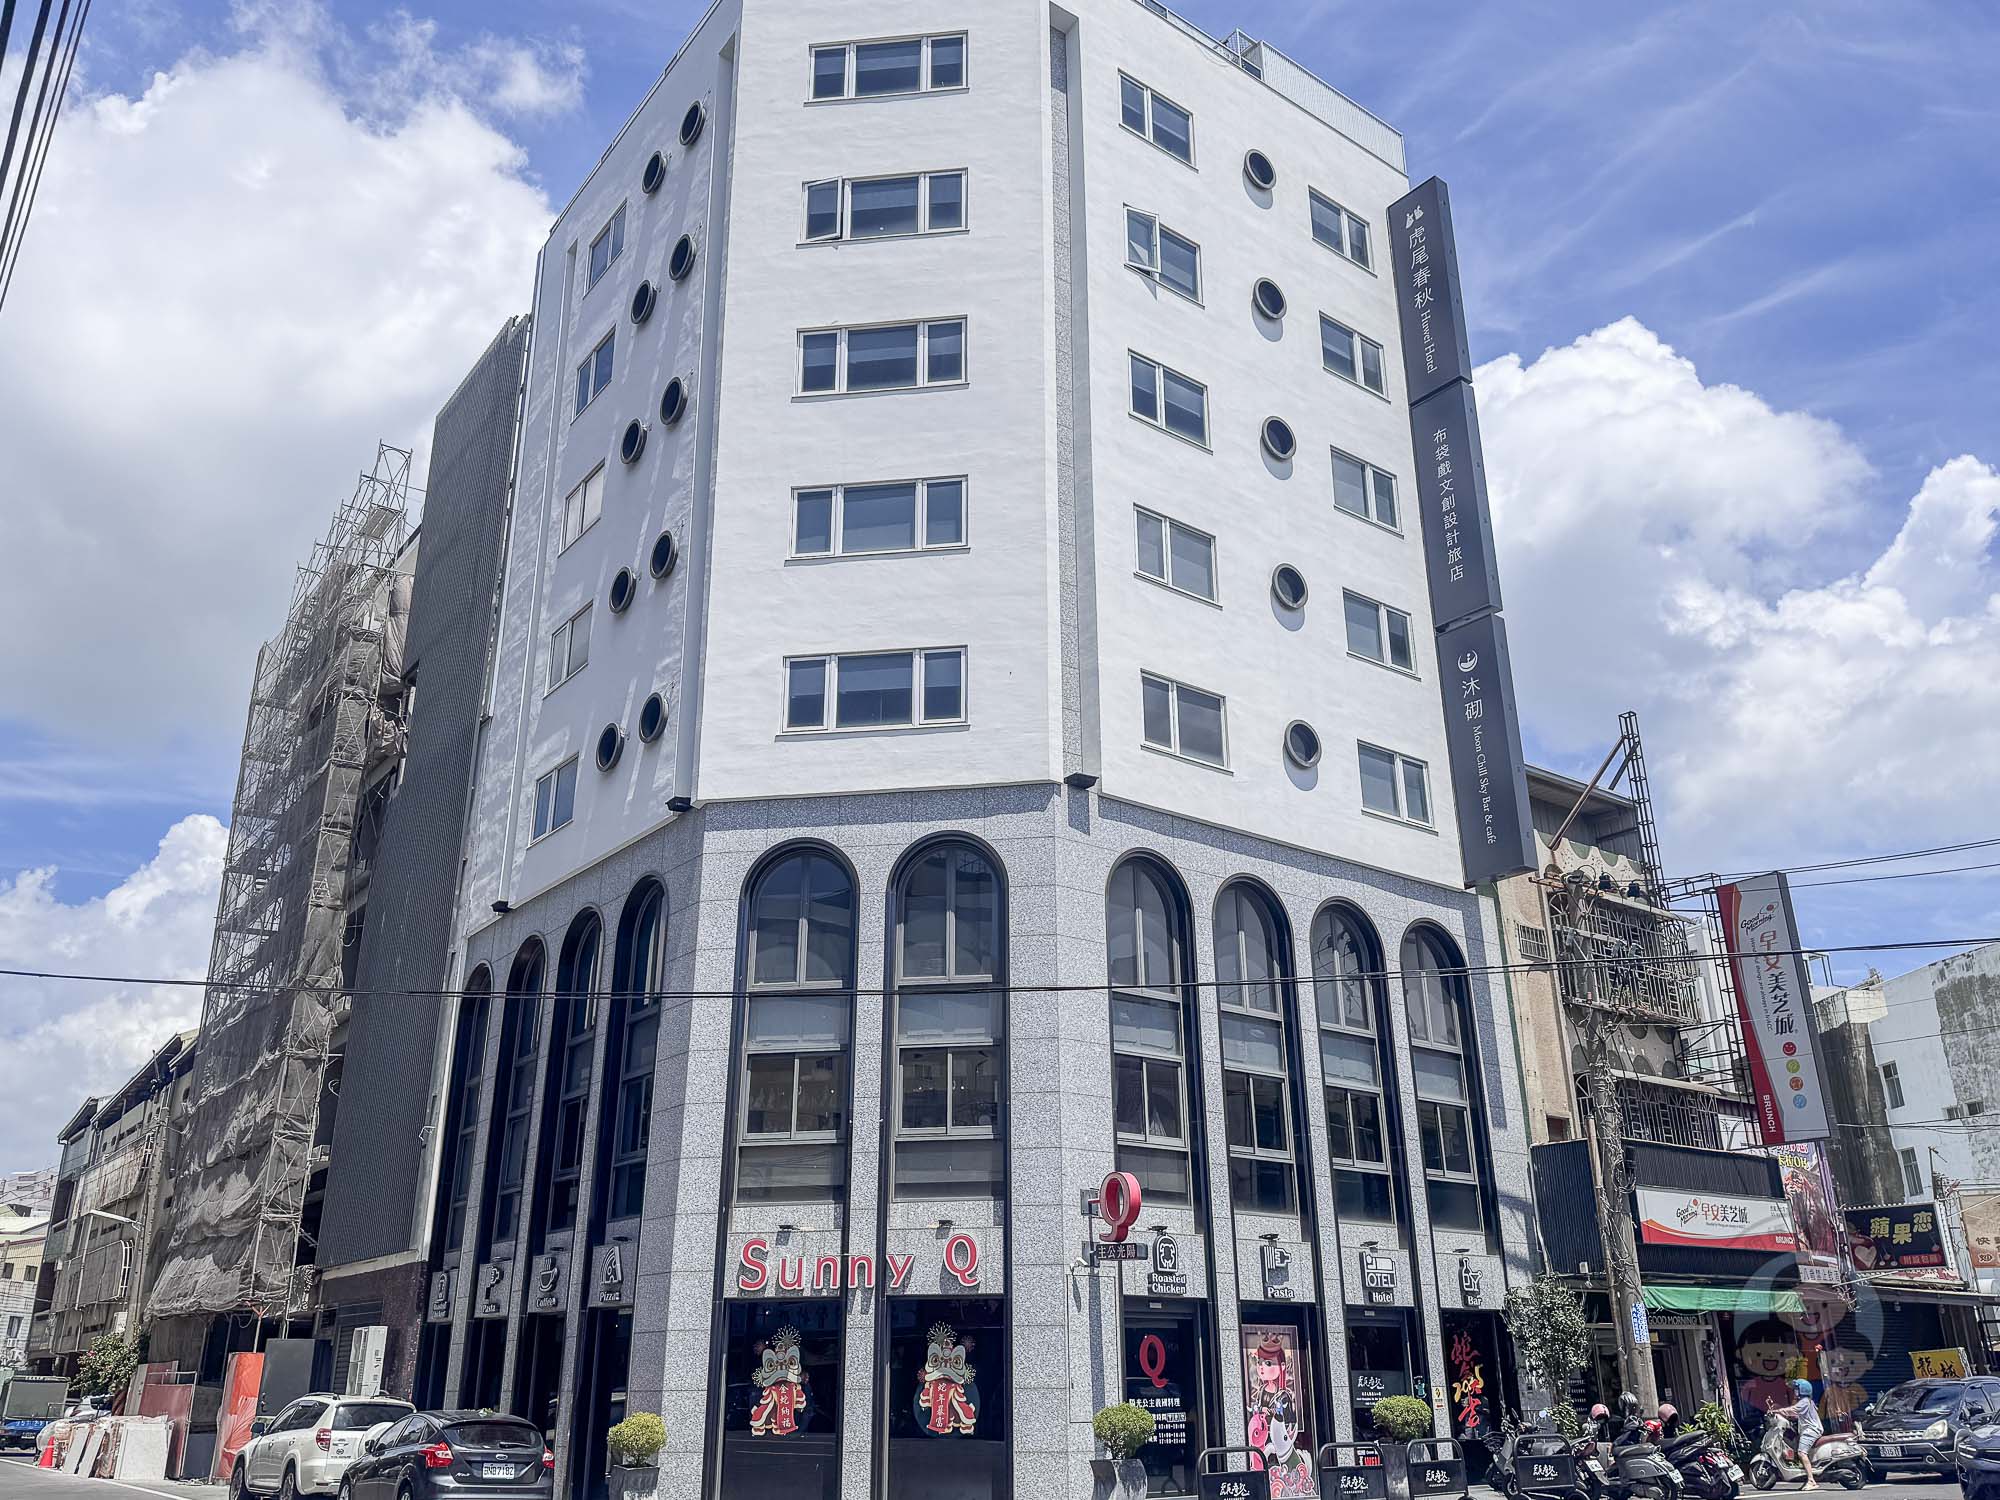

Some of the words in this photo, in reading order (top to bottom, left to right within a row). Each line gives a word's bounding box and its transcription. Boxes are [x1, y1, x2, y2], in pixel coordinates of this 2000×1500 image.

[1409, 225, 1434, 309] 虎尾春秋
[1425, 343, 1438, 374] Hotel
[1433, 428, 1464, 583] 布袋戲文創設計旅店
[1461, 677, 1483, 721] 沐砌
[1472, 724, 1482, 753] Moon
[1476, 753, 1488, 778] Chill
[1479, 778, 1489, 795] Sky
[1482, 796, 1491, 813] Bar
[1484, 813, 1493, 824] &
[1763, 1095, 1777, 1133] BRUNCH
[1701, 1203, 1748, 1224] 早安美芝城
[738, 1238, 914, 1291] Sunny
[945, 1234, 979, 1287] Q
[1152, 1274, 1186, 1284] Roasted
[1152, 1283, 1186, 1294] Chicken
[1267, 1286, 1295, 1298] Pasta
[1372, 1292, 1393, 1303] Hotel
[1467, 1295, 1482, 1306] Bar
[1648, 1316, 1666, 1325] GOOD
[1139, 1334, 1168, 1388] Q
[779, 1383, 791, 1428] 金蛇納福
[935, 1382, 947, 1428] 蛇年暴富
